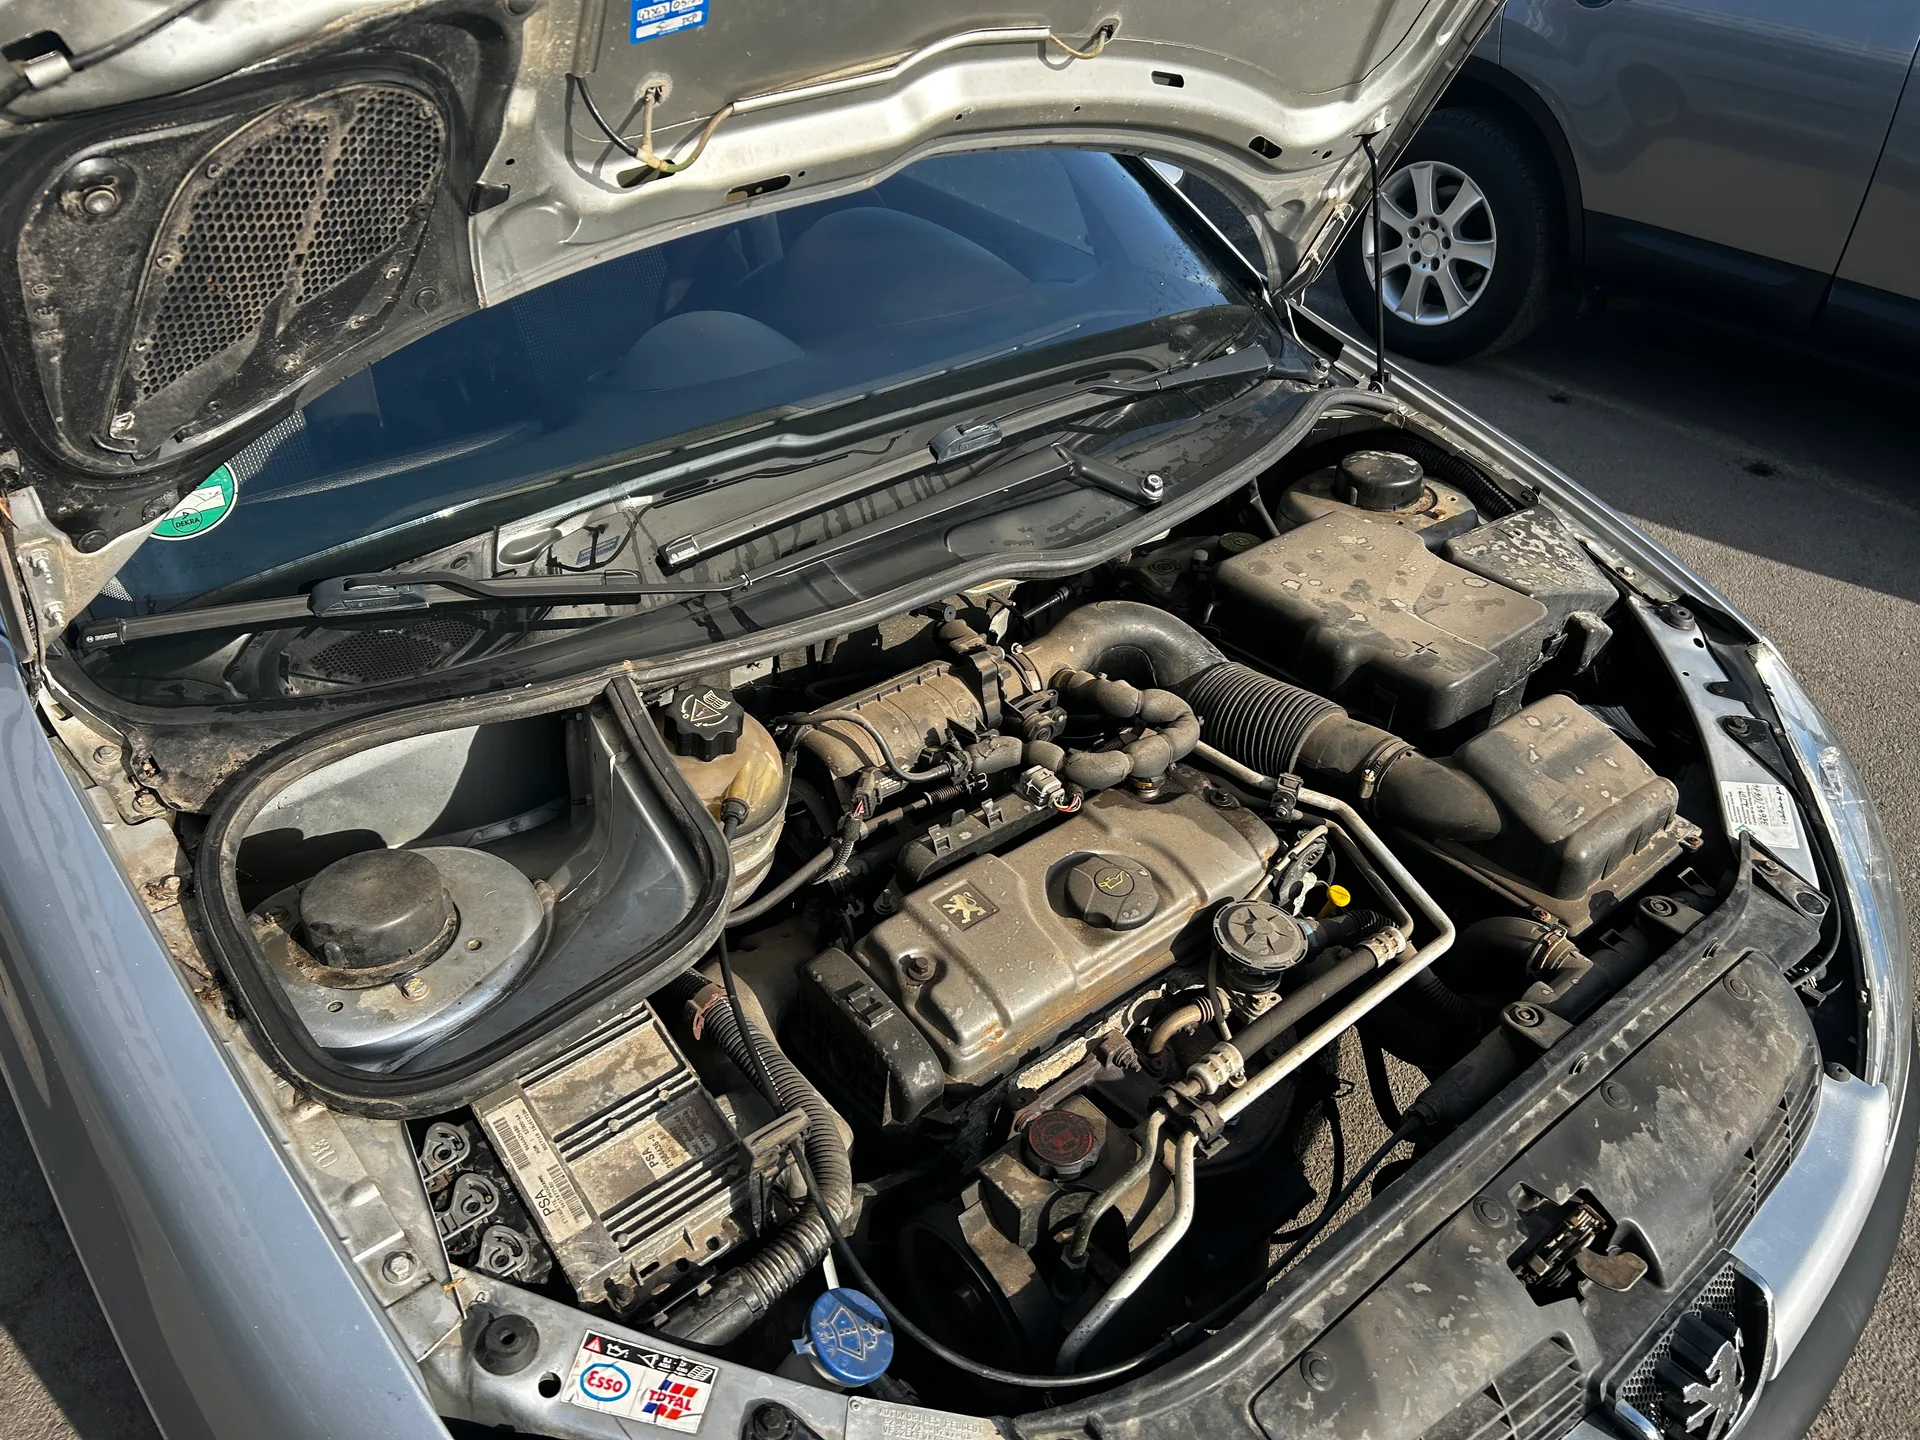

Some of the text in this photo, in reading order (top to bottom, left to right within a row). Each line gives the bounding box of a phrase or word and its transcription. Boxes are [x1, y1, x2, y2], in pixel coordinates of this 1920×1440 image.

[175, 517, 200, 528] DEKRA
[641, 1148, 658, 1169] PSA
[535, 1189, 555, 1216] PSA
[649, 1389, 692, 1411] TOTAL
[878, 1407, 939, 1426] AUTOMOBILES
[944, 1418, 984, 1434] PEUGEOT
